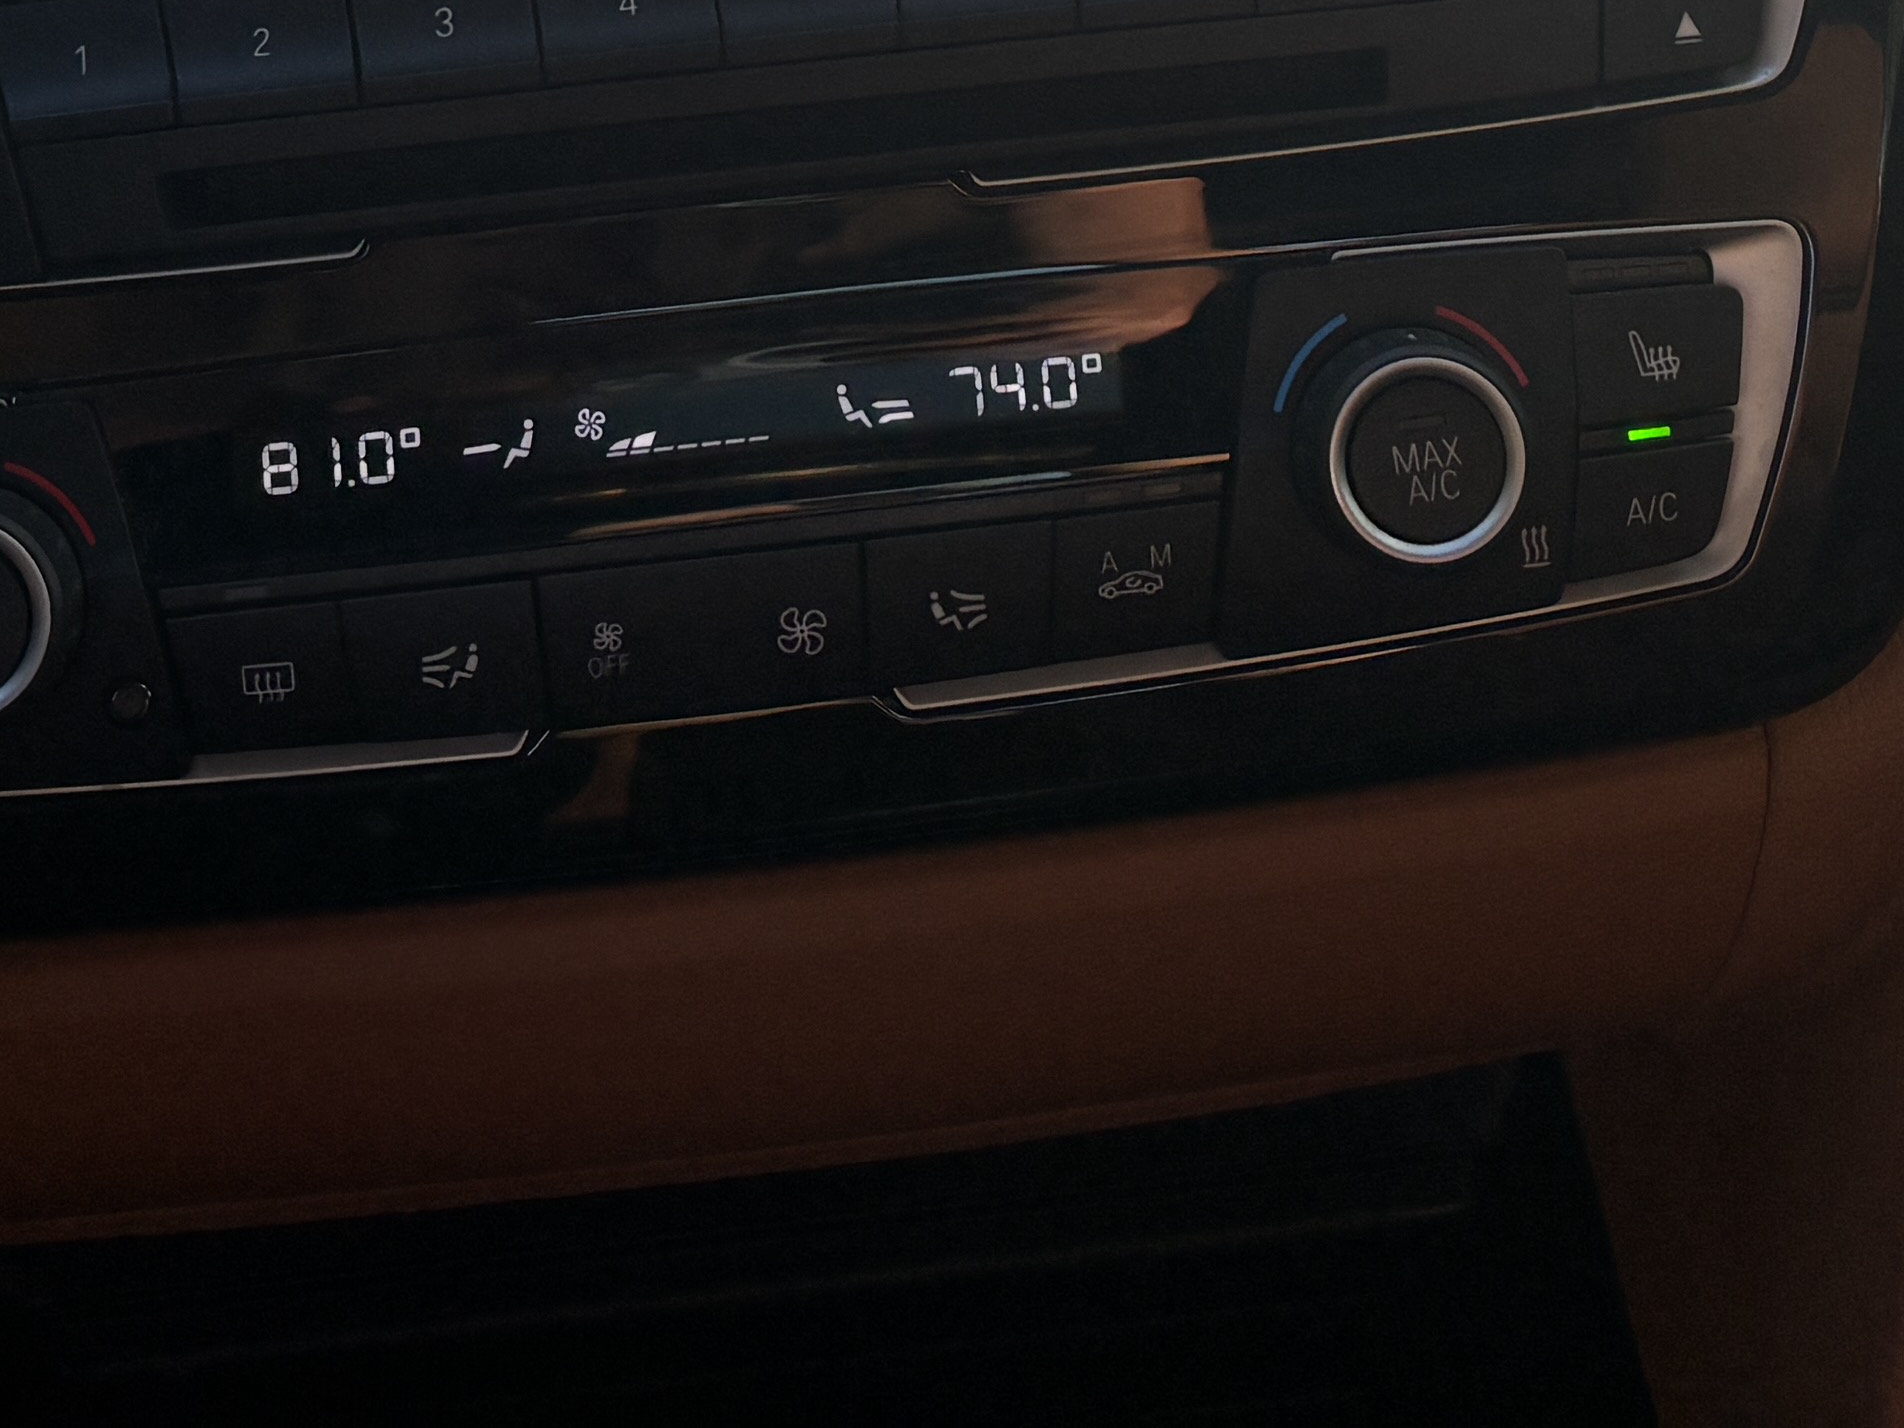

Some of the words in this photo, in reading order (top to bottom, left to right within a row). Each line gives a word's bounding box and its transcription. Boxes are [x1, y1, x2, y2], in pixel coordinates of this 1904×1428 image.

[435, 7, 453, 37] 3
[254, 28, 269, 56] 2
[76, 45, 86, 74] 1
[1392, 437, 1462, 473] MAX
[1408, 469, 1461, 504] A/C
[1627, 492, 1677, 525] A/C
[1102, 552, 1118, 574] A
[1150, 544, 1172, 568] M
[588, 653, 630, 679] OFF
